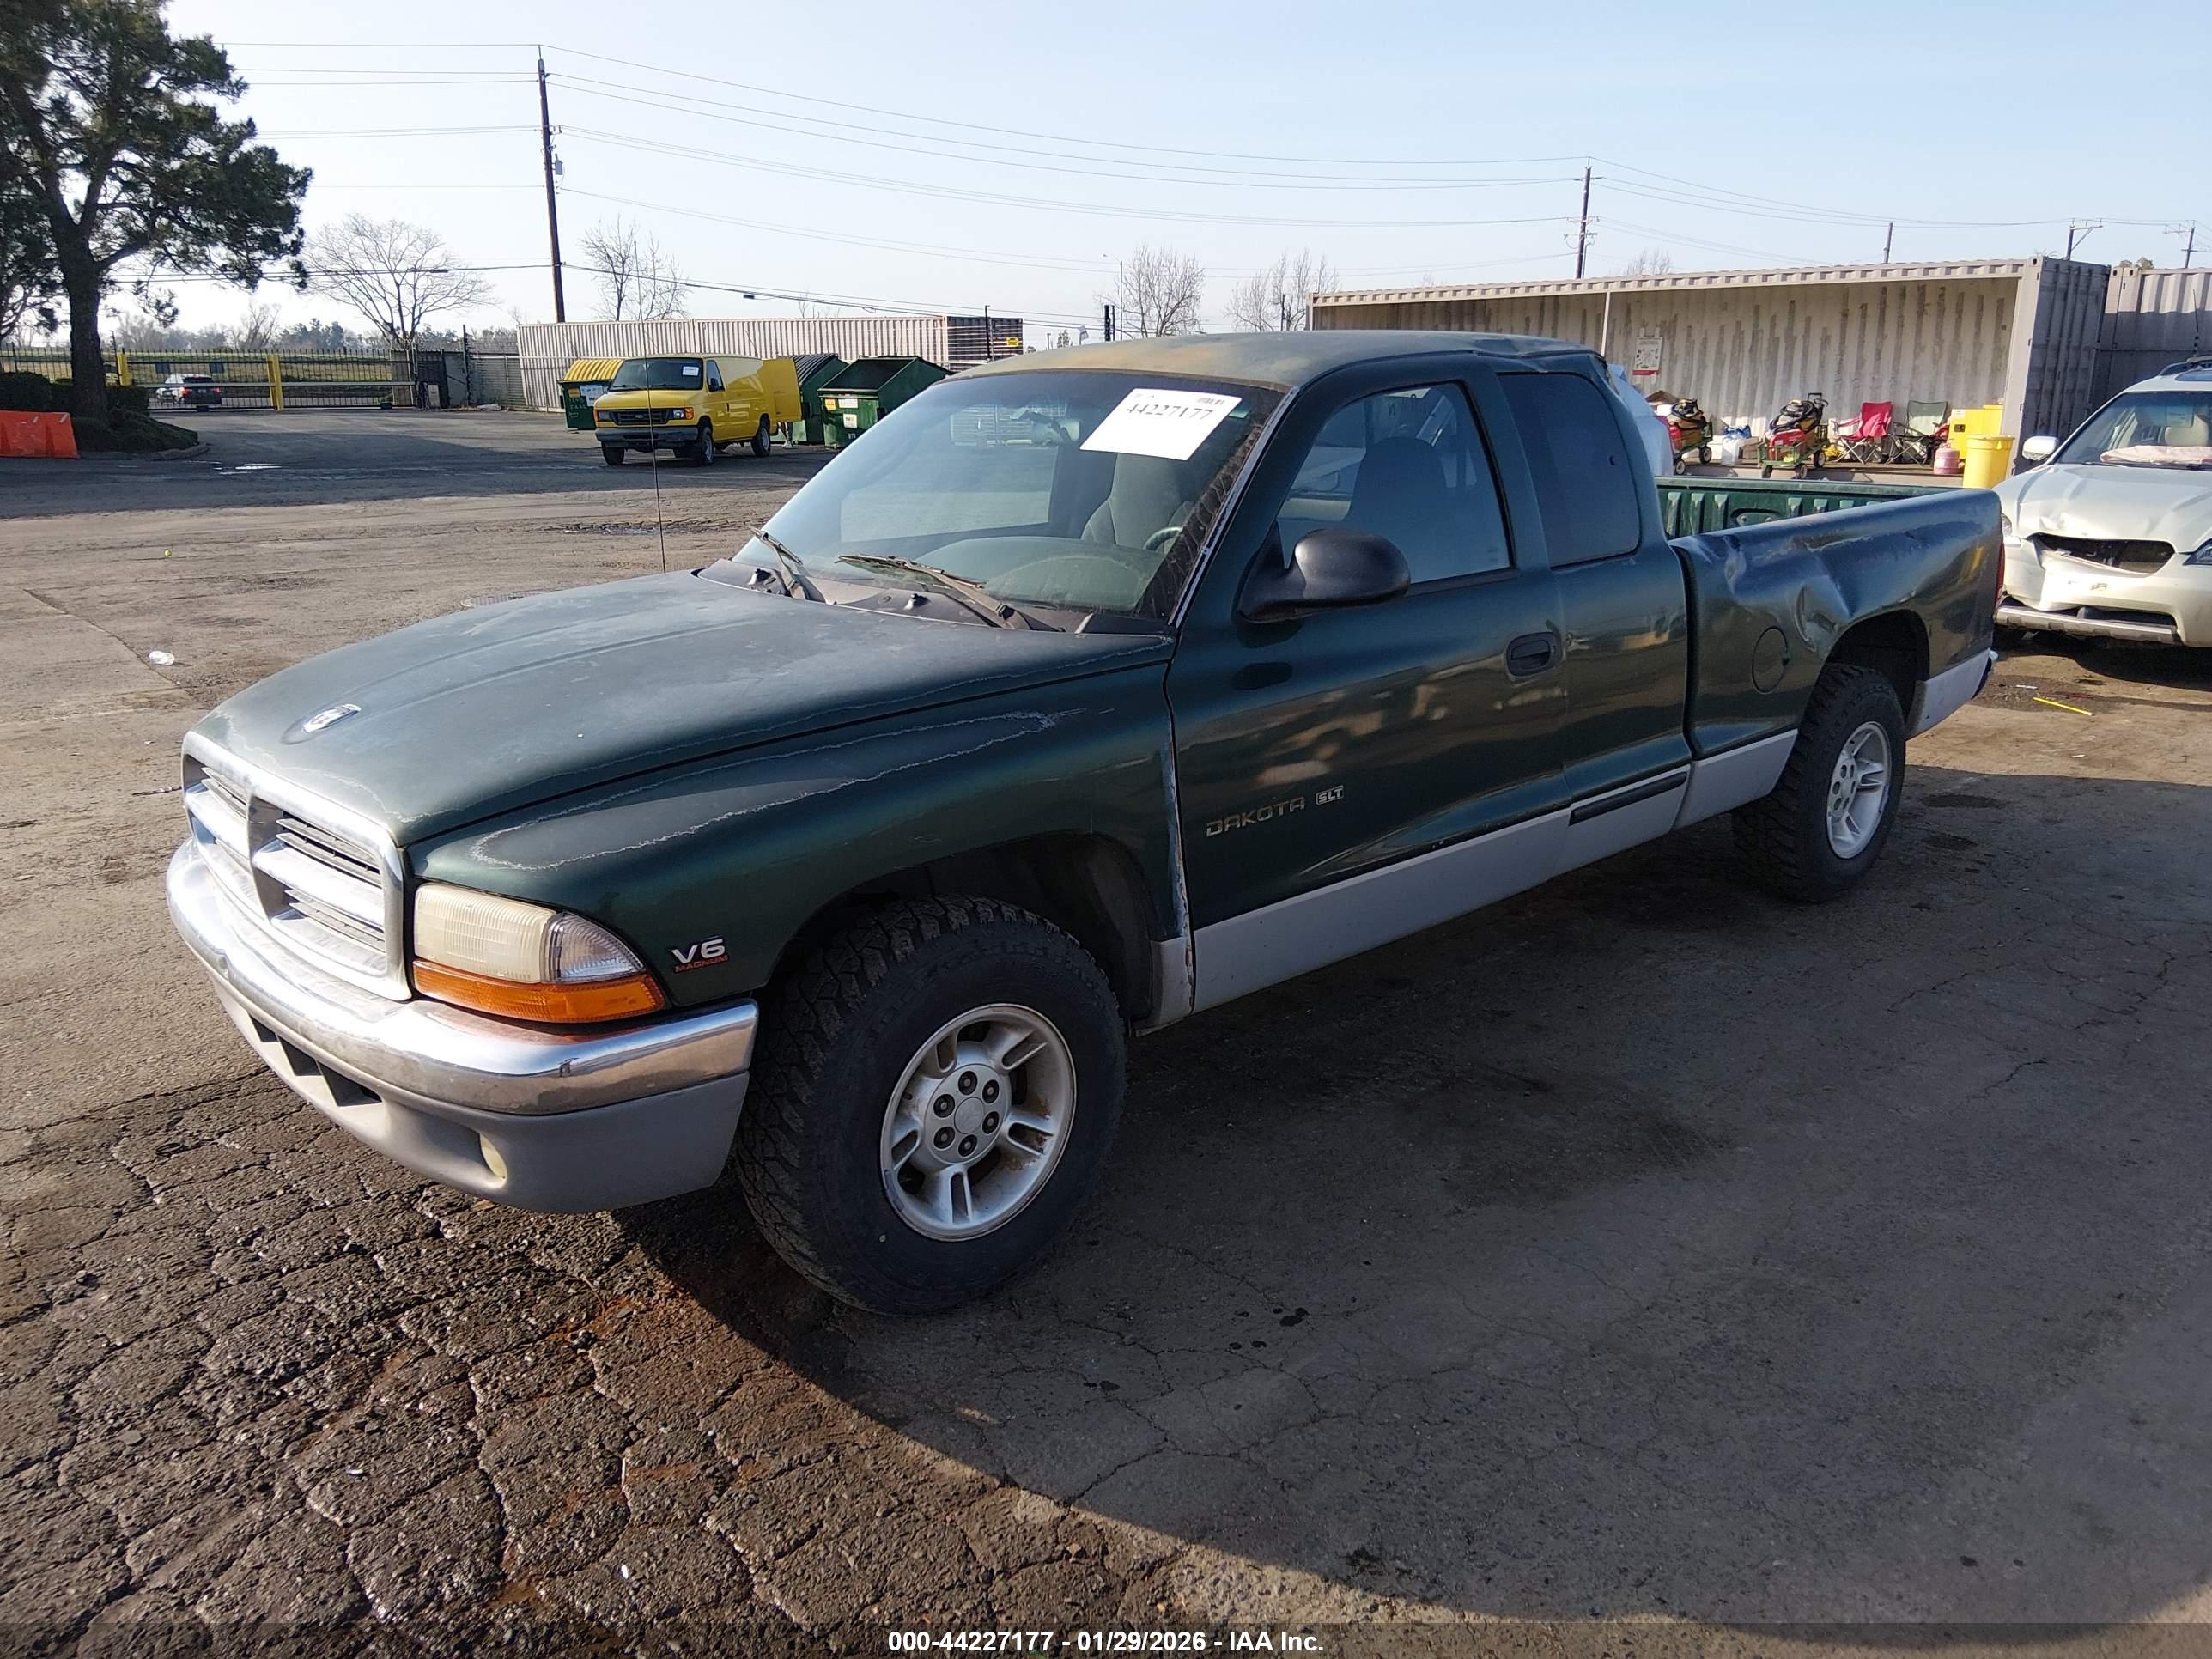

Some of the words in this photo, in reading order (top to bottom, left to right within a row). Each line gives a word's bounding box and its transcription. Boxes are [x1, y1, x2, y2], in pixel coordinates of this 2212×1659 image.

[1126, 404, 1214, 420] 44227177
[1206, 796, 1306, 837] DAKOTA
[1317, 785, 1344, 804] SLT
[671, 938, 726, 963] V6
[674, 955, 729, 973] MAGNUM
